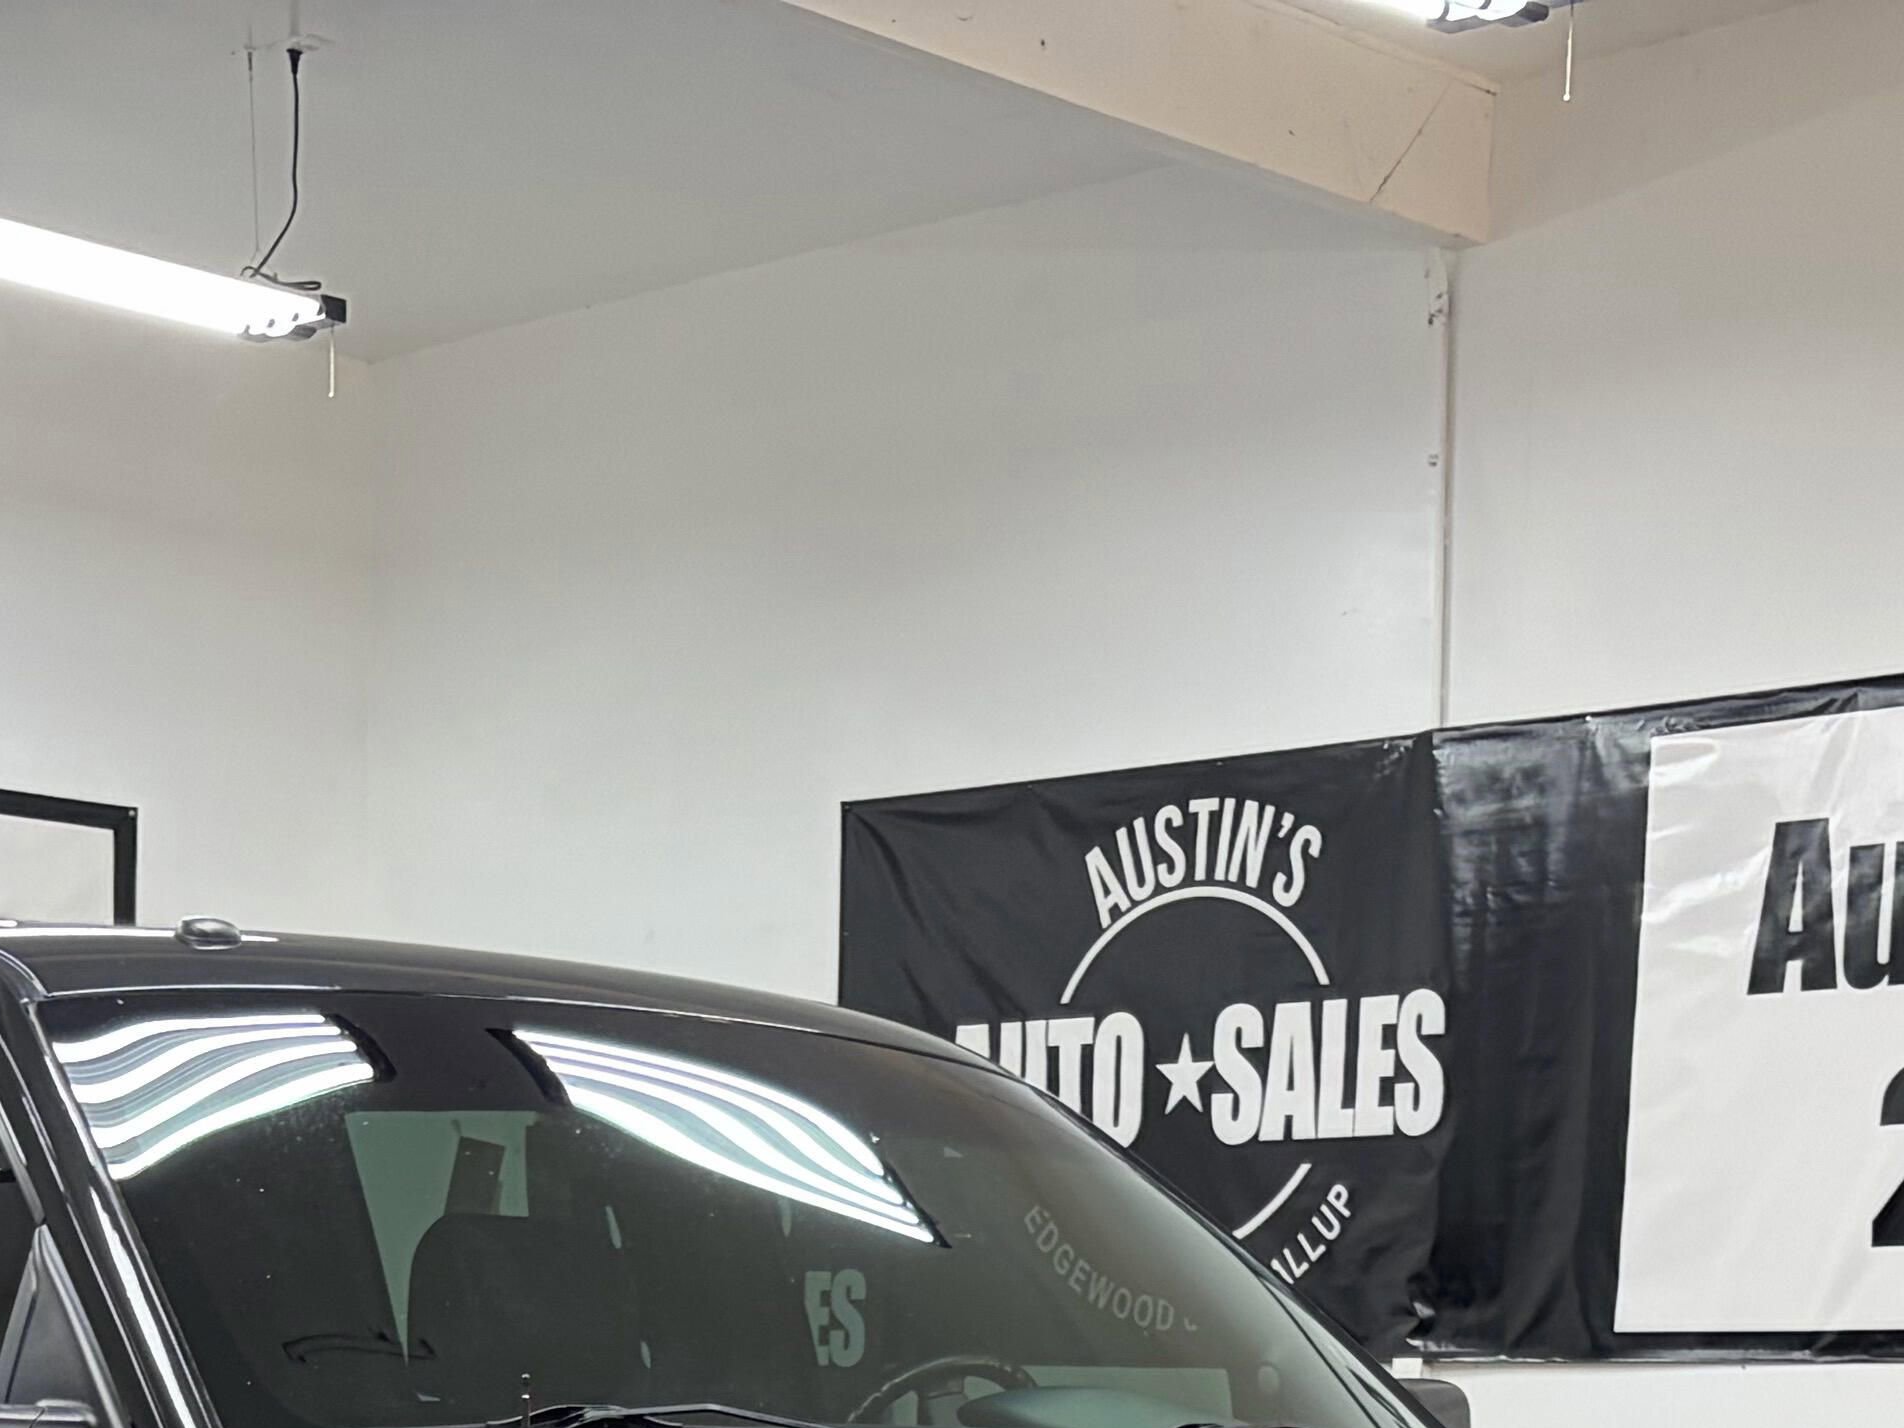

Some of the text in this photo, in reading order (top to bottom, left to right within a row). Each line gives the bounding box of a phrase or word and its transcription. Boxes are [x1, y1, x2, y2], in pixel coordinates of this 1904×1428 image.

[1084, 797, 1322, 929] AUSTIN'S
[1211, 988, 1446, 1146] SALES
[1023, 1204, 1176, 1332] EDGEWOOD
